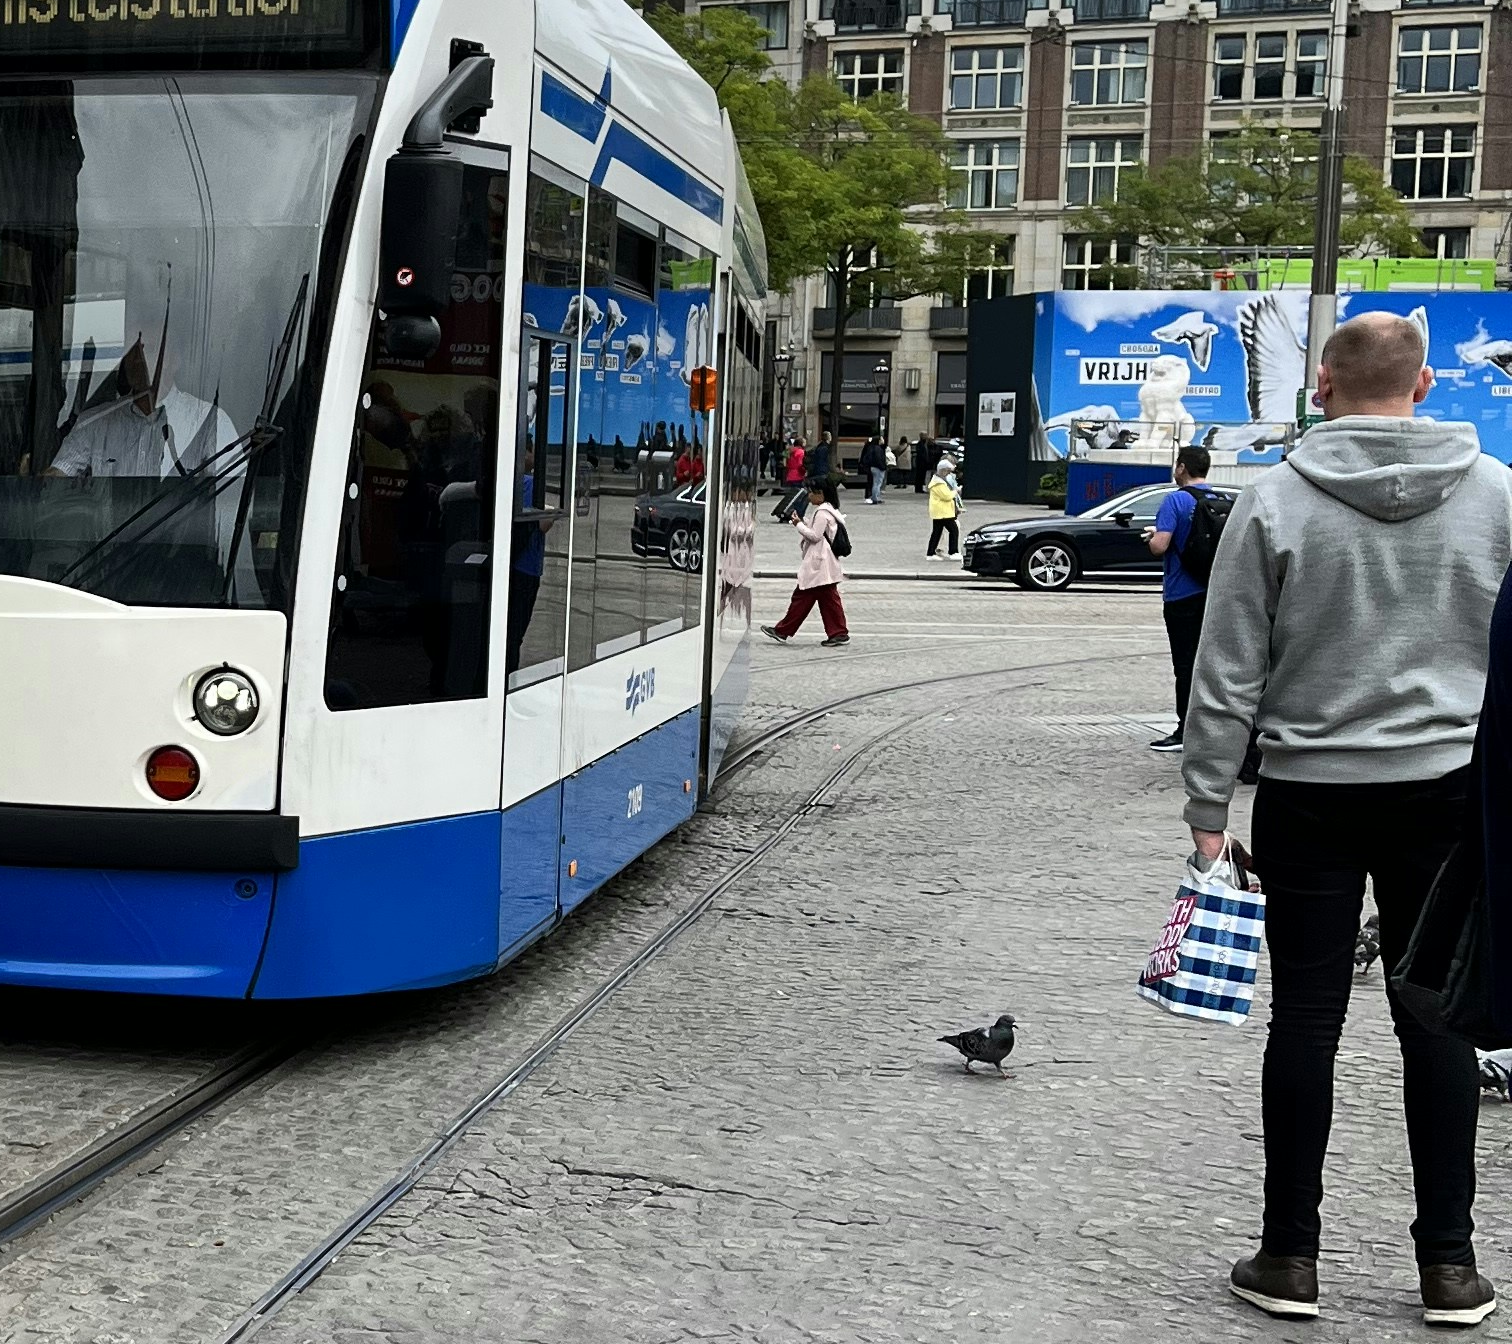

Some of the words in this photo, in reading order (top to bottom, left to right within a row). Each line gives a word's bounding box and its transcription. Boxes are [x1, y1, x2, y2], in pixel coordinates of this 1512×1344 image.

[1085, 362, 1148, 381] VRIJH
[1185, 387, 1219, 395] IBERTAD
[640, 667, 655, 703] GVB
[627, 783, 643, 819] 2109
